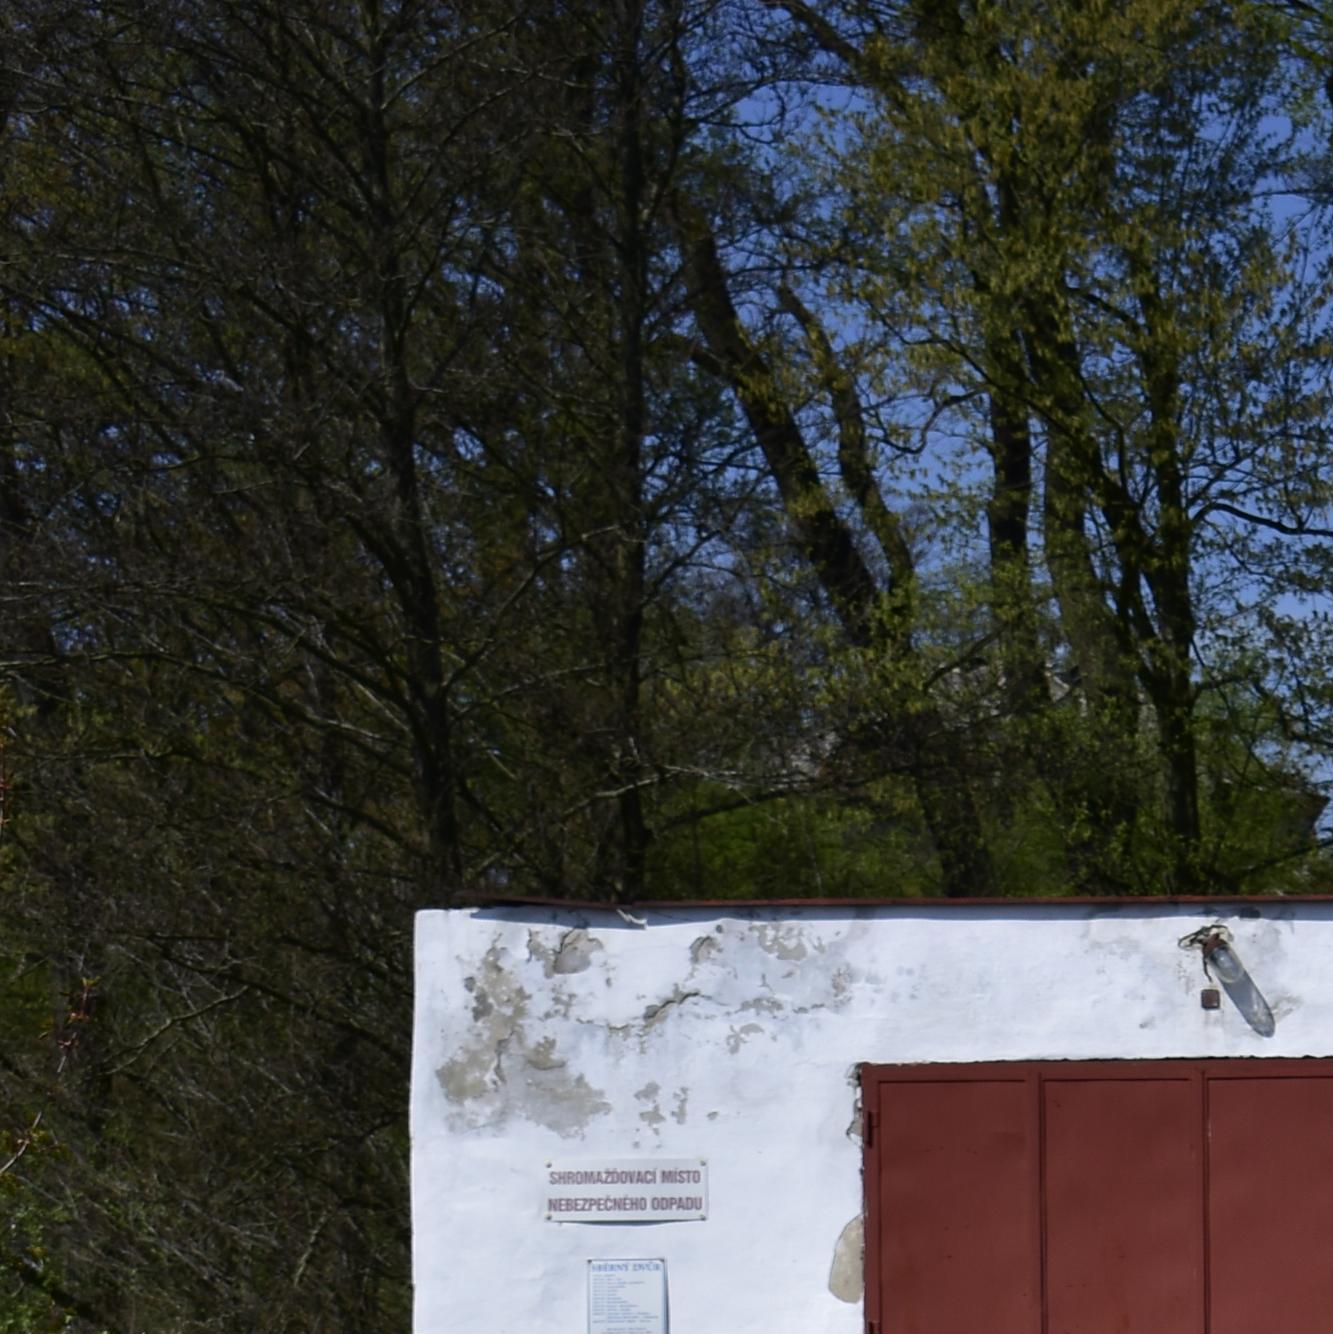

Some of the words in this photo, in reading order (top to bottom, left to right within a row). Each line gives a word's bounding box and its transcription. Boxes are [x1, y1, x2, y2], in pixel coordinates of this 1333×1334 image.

[550, 1168, 657, 1185] SHROMAŽĎOVACÍ
[661, 1168, 701, 1184] MÍSTO
[548, 1195, 647, 1212] NEBEZPEČNÉHO
[652, 1197, 703, 1211] ODPADU
